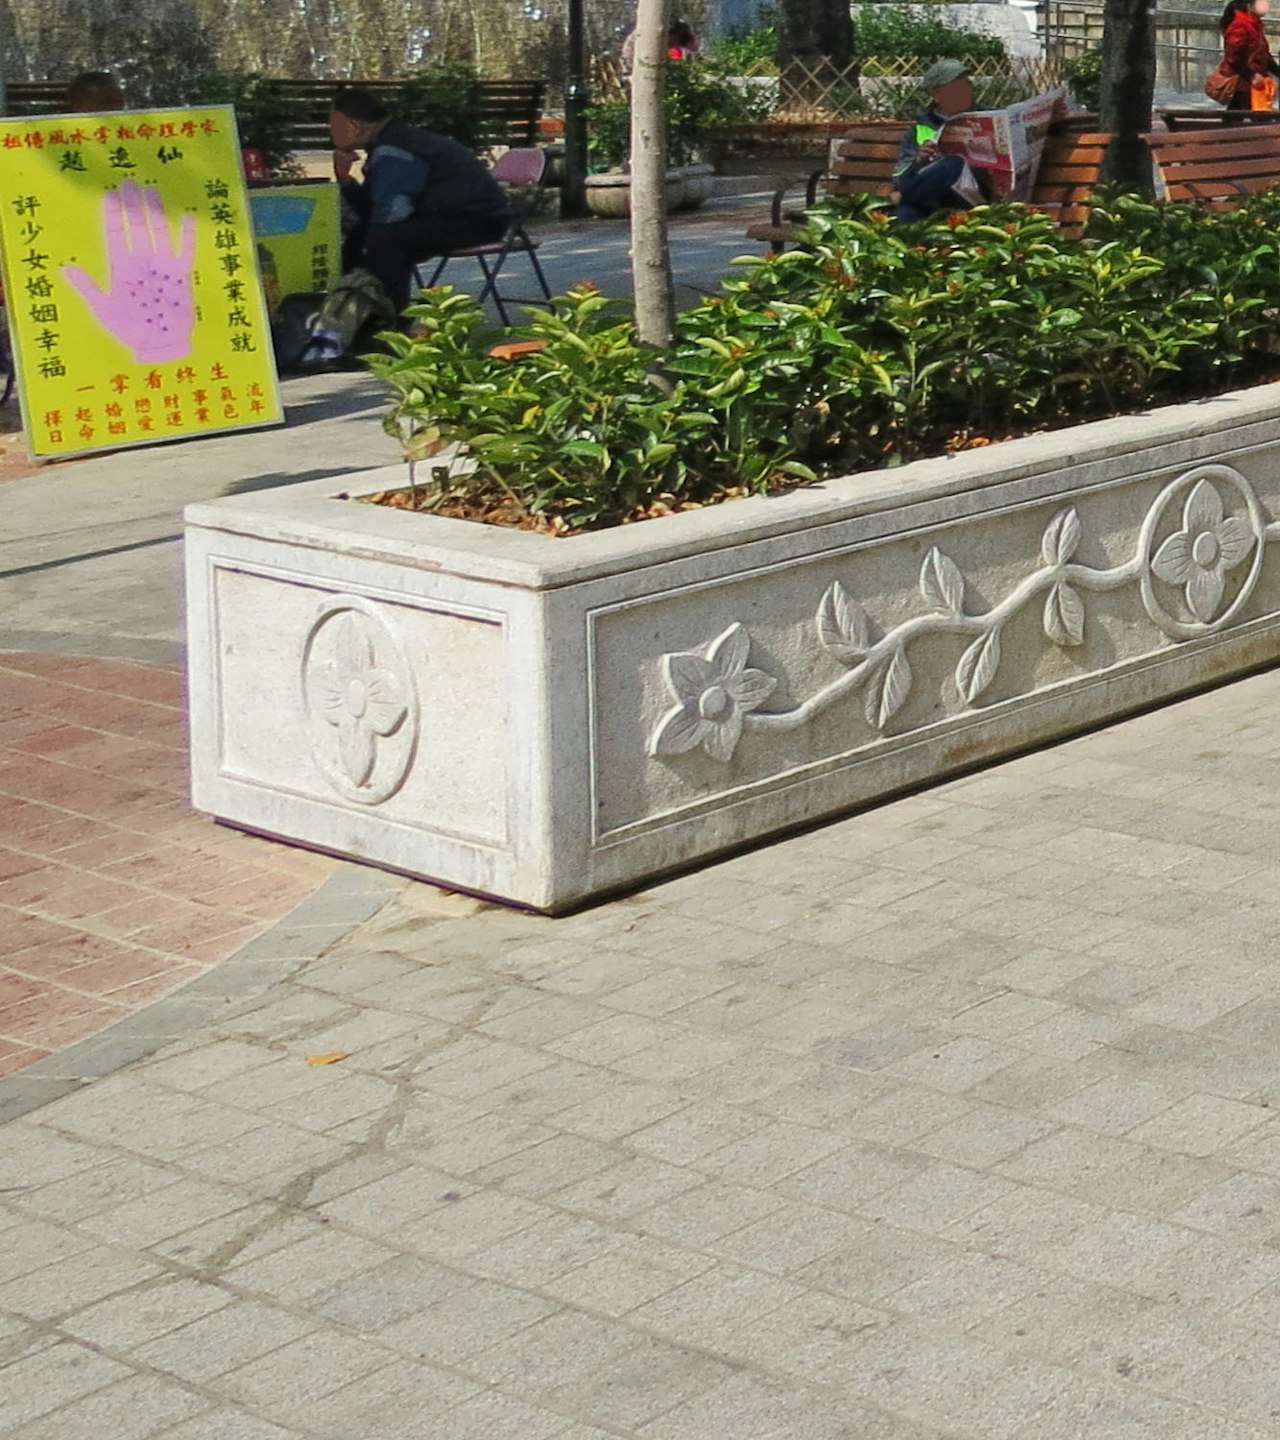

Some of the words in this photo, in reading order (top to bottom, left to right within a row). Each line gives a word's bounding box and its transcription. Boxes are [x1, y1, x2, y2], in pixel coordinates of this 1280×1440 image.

[12, 195, 66, 379] 評少女婚姻幸福
[204, 179, 257, 352] 論英雄事業成就
[191, 389, 210, 422] 事業
